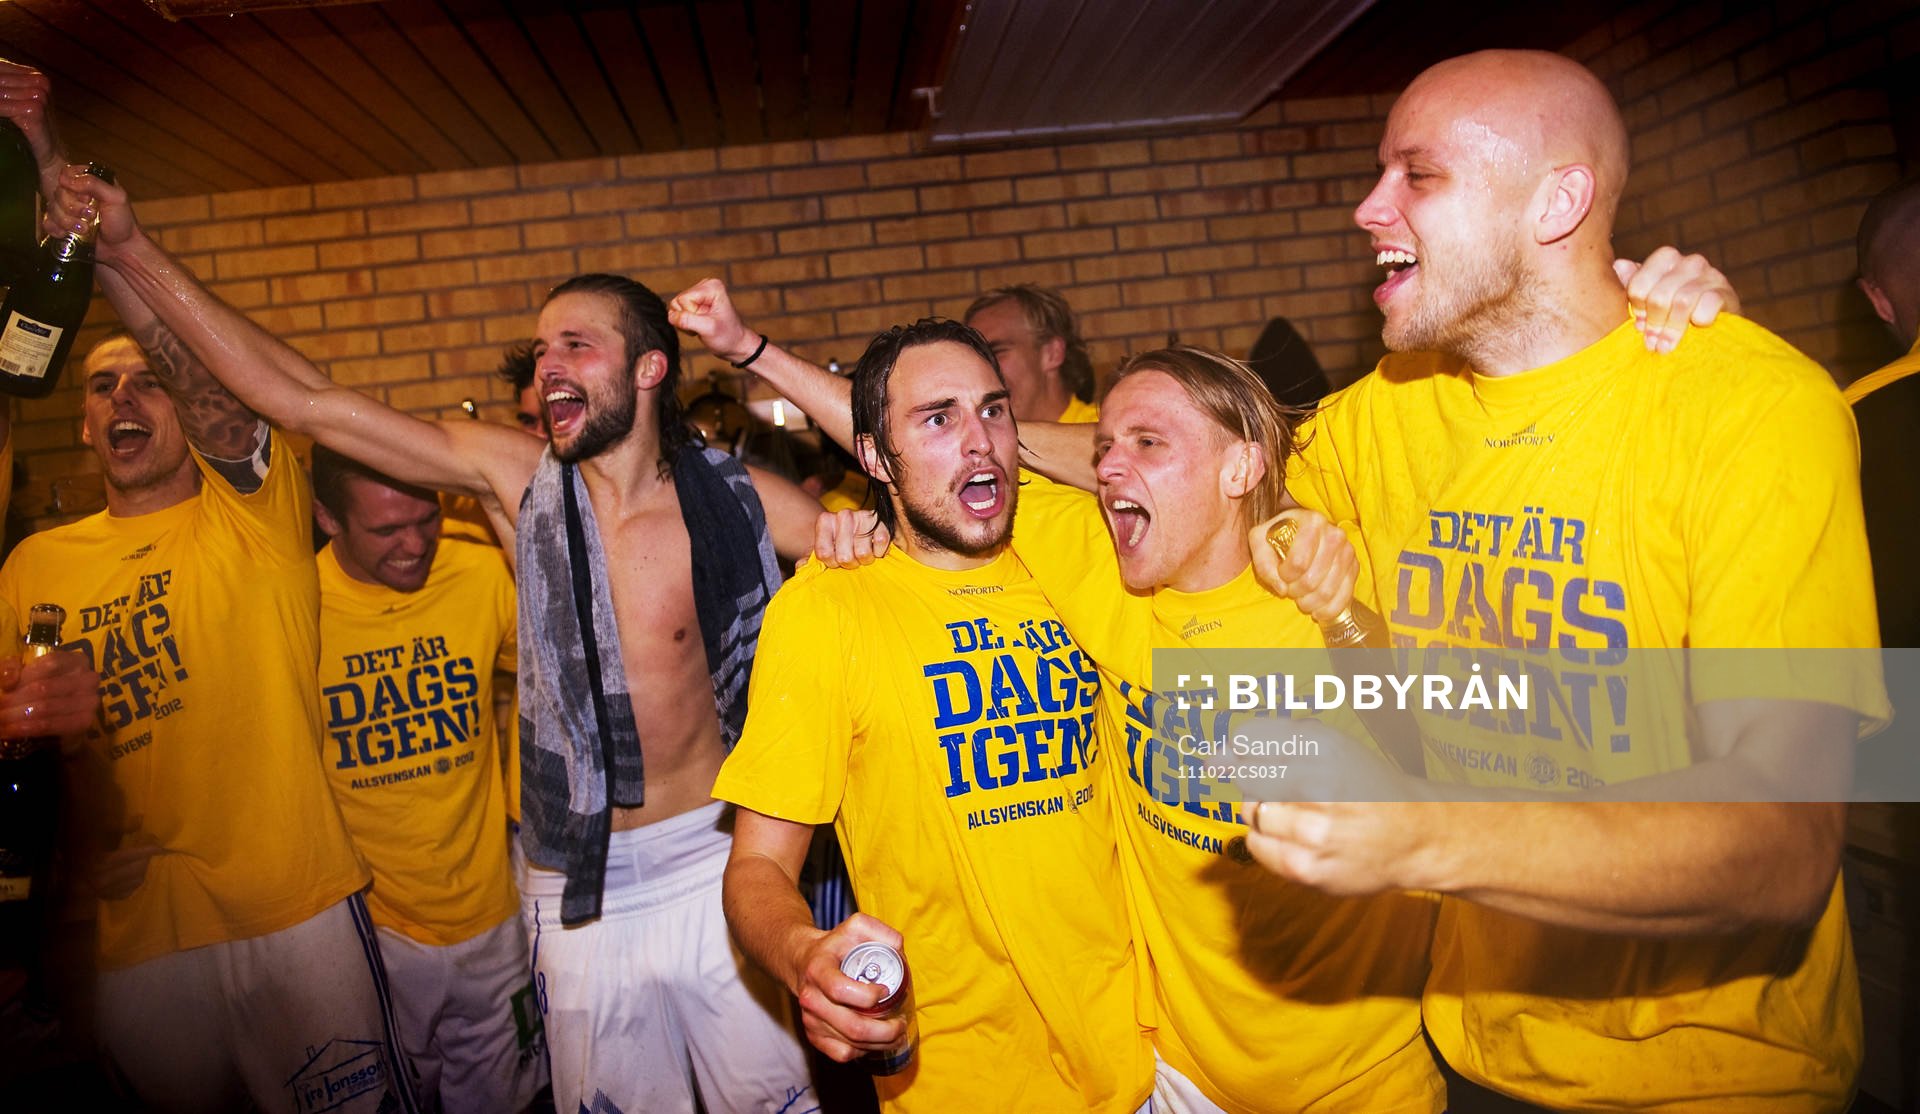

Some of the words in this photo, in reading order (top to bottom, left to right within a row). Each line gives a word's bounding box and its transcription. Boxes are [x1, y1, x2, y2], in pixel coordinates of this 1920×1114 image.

[1485, 433, 1555, 448] NORRPORTN
[1428, 509, 1513, 556] DET
[1512, 506, 1585, 565] ÄR
[946, 617, 1012, 653] DE
[1390, 550, 1628, 666] DAGS
[343, 645, 405, 679] DET
[411, 635, 449, 665] ÄR
[322, 656, 479, 729] DAGS
[923, 650, 1100, 730] DAGS
[1390, 633, 1631, 754] IGEN!
[331, 700, 481, 770] IGEN!
[351, 764, 432, 790] ALLSVENSKAN
[455, 751, 475, 768] 2012
[967, 796, 1064, 830] ALLSVENSKAN
[1137, 803, 1223, 855] ALLSVENSKAN
